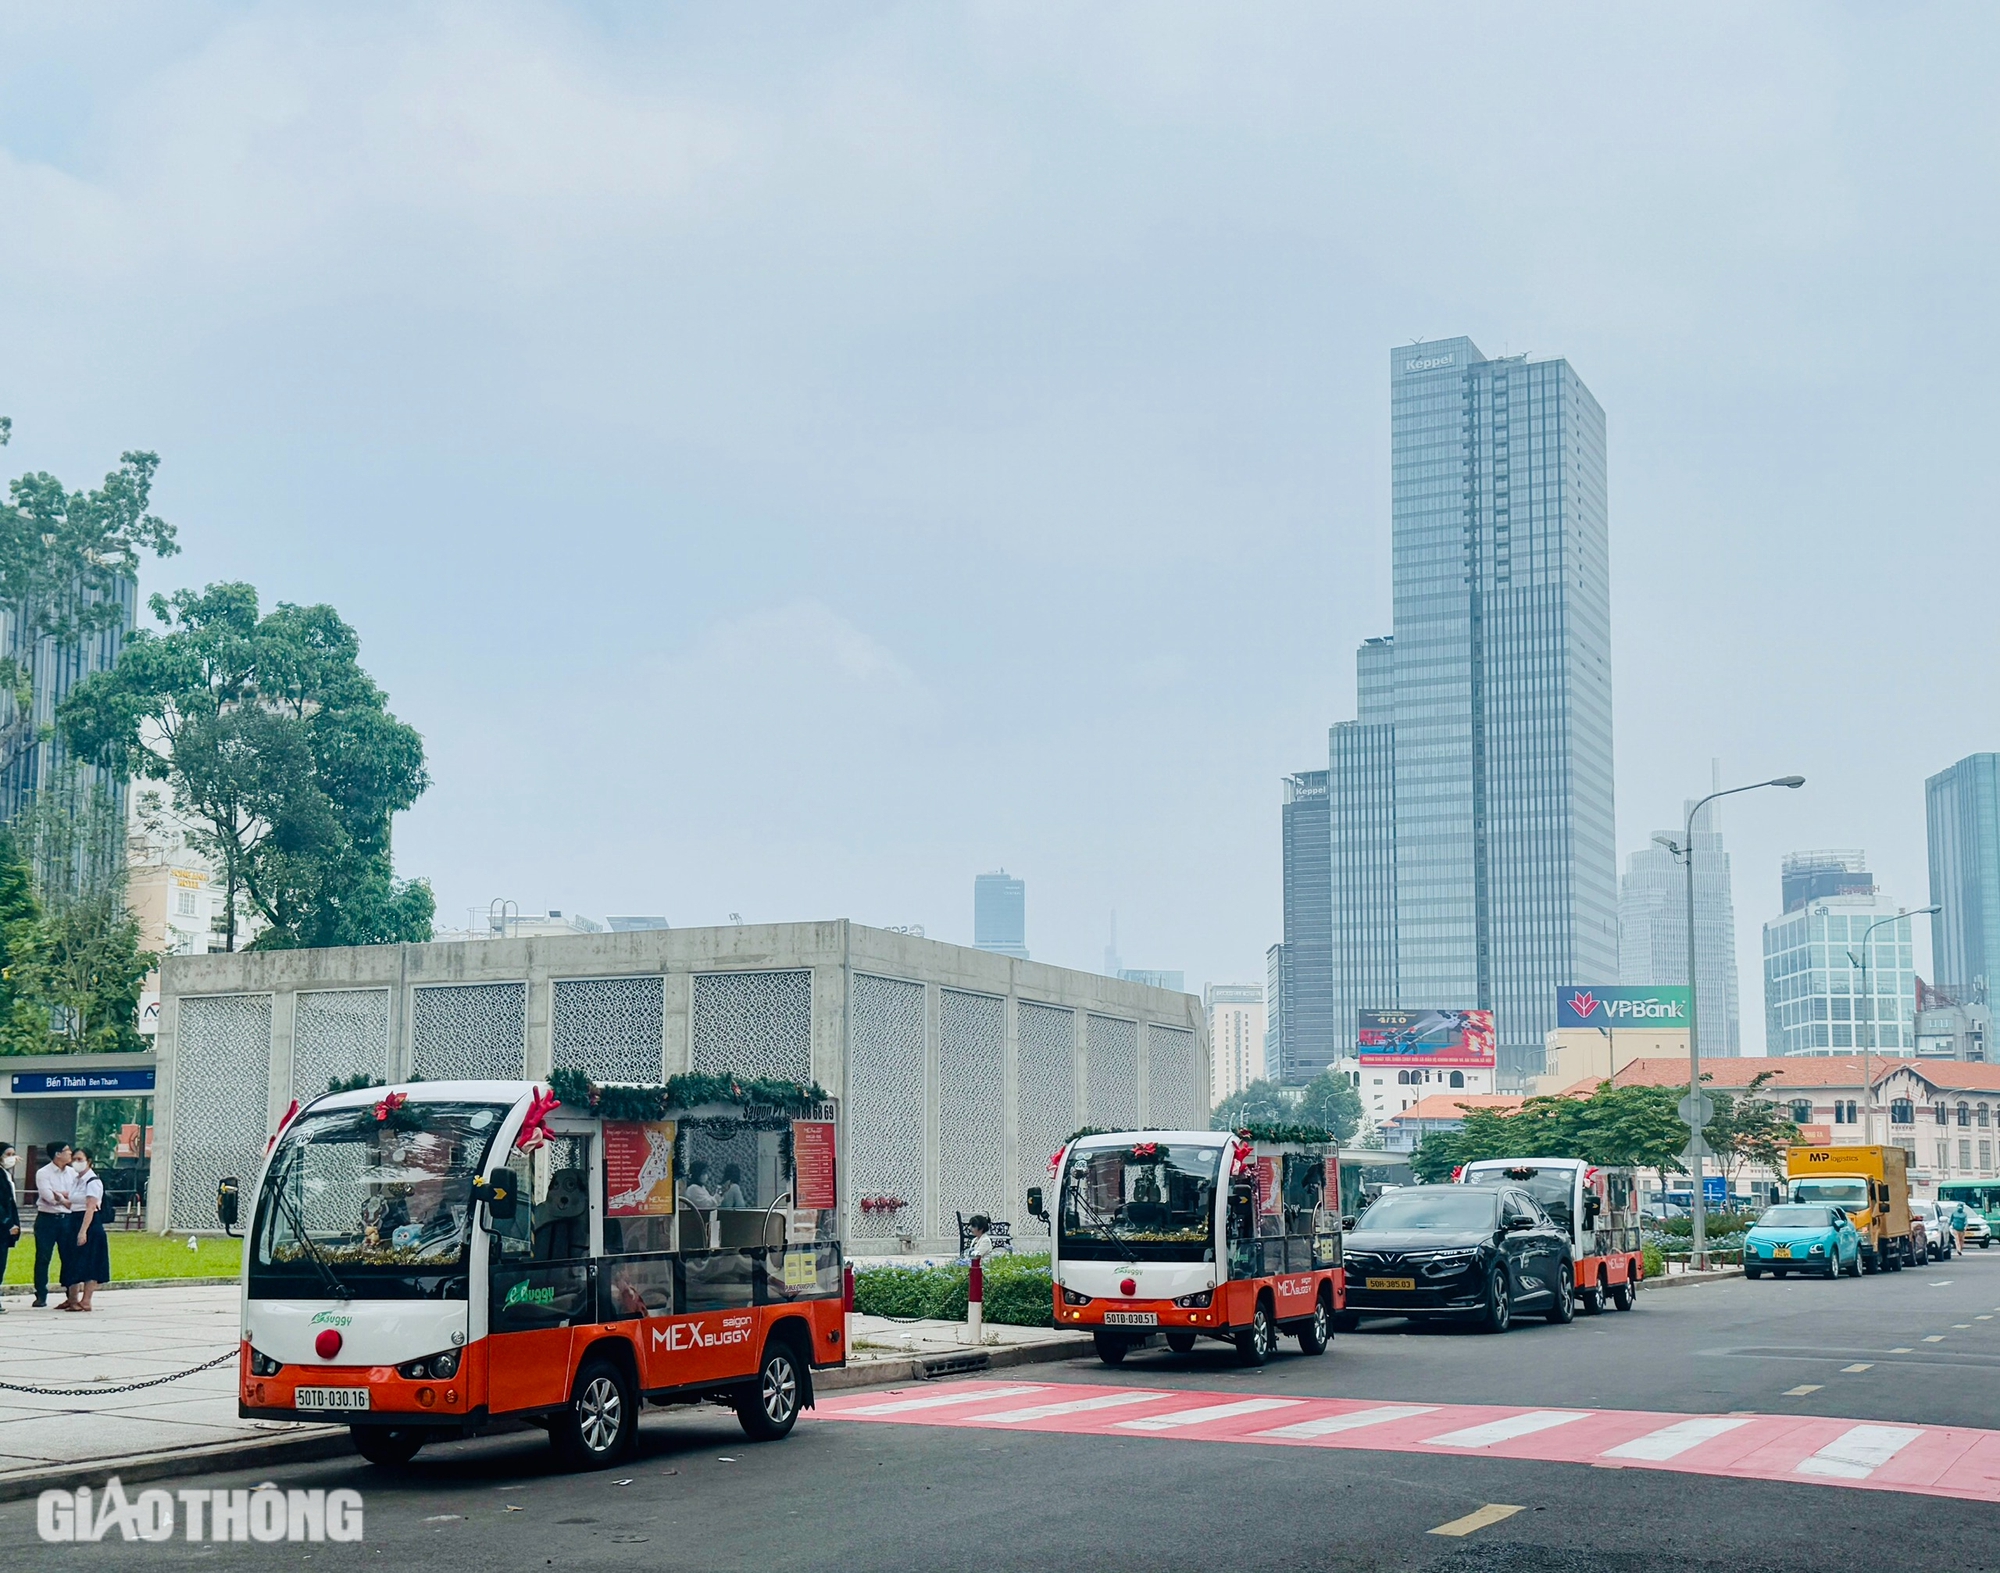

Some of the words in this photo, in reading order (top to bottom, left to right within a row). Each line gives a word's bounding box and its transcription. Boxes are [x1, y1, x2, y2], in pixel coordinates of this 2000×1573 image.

[1405, 353, 1454, 371] Keppel
[1296, 786, 1326, 796] Keppel
[1602, 999, 1685, 1018] VPBank
[1377, 1016, 1407, 1024] 4/10
[46, 1076, 61, 1088] Bến
[89, 1078, 100, 1086] Ben
[101, 1078, 118, 1086] Thanh
[801, 1104, 811, 1120] 88
[812, 1104, 823, 1120] 68
[824, 1104, 834, 1120] 69
[1809, 1152, 1830, 1162] MP
[1830, 1154, 1859, 1163] logistics
[1277, 1279, 1296, 1297] MEX
[722, 1315, 752, 1328] saigon
[1106, 1313, 1154, 1324] 50TD-030.51
[652, 1321, 705, 1353] MEX
[704, 1329, 752, 1347] BUGGY
[297, 1388, 366, 1407] 50TD-030.16
